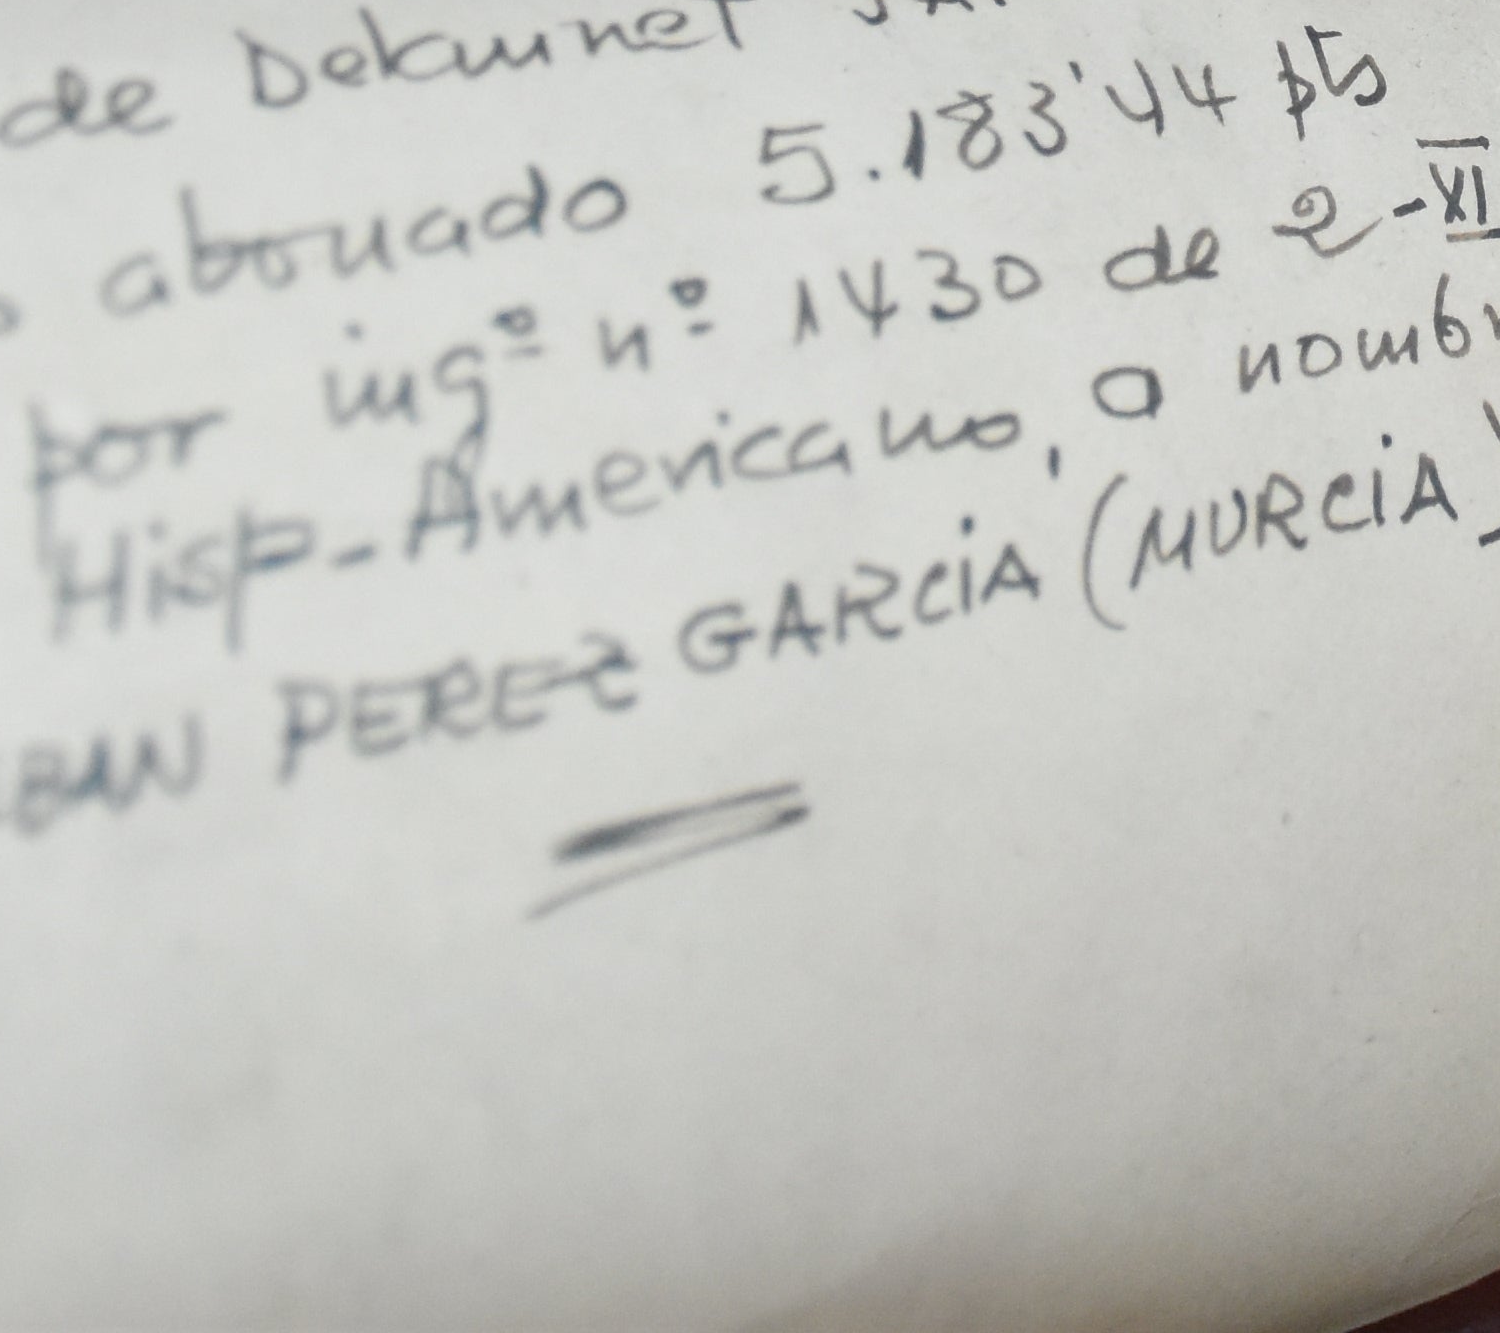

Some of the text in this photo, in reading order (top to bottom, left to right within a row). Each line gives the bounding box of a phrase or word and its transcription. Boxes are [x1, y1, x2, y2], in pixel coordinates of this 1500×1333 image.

[100, 163, 628, 317] abonado
[26, 400, 228, 575] por
[793, 251, 1044, 345] 1430
[1101, 222, 1222, 292] de
